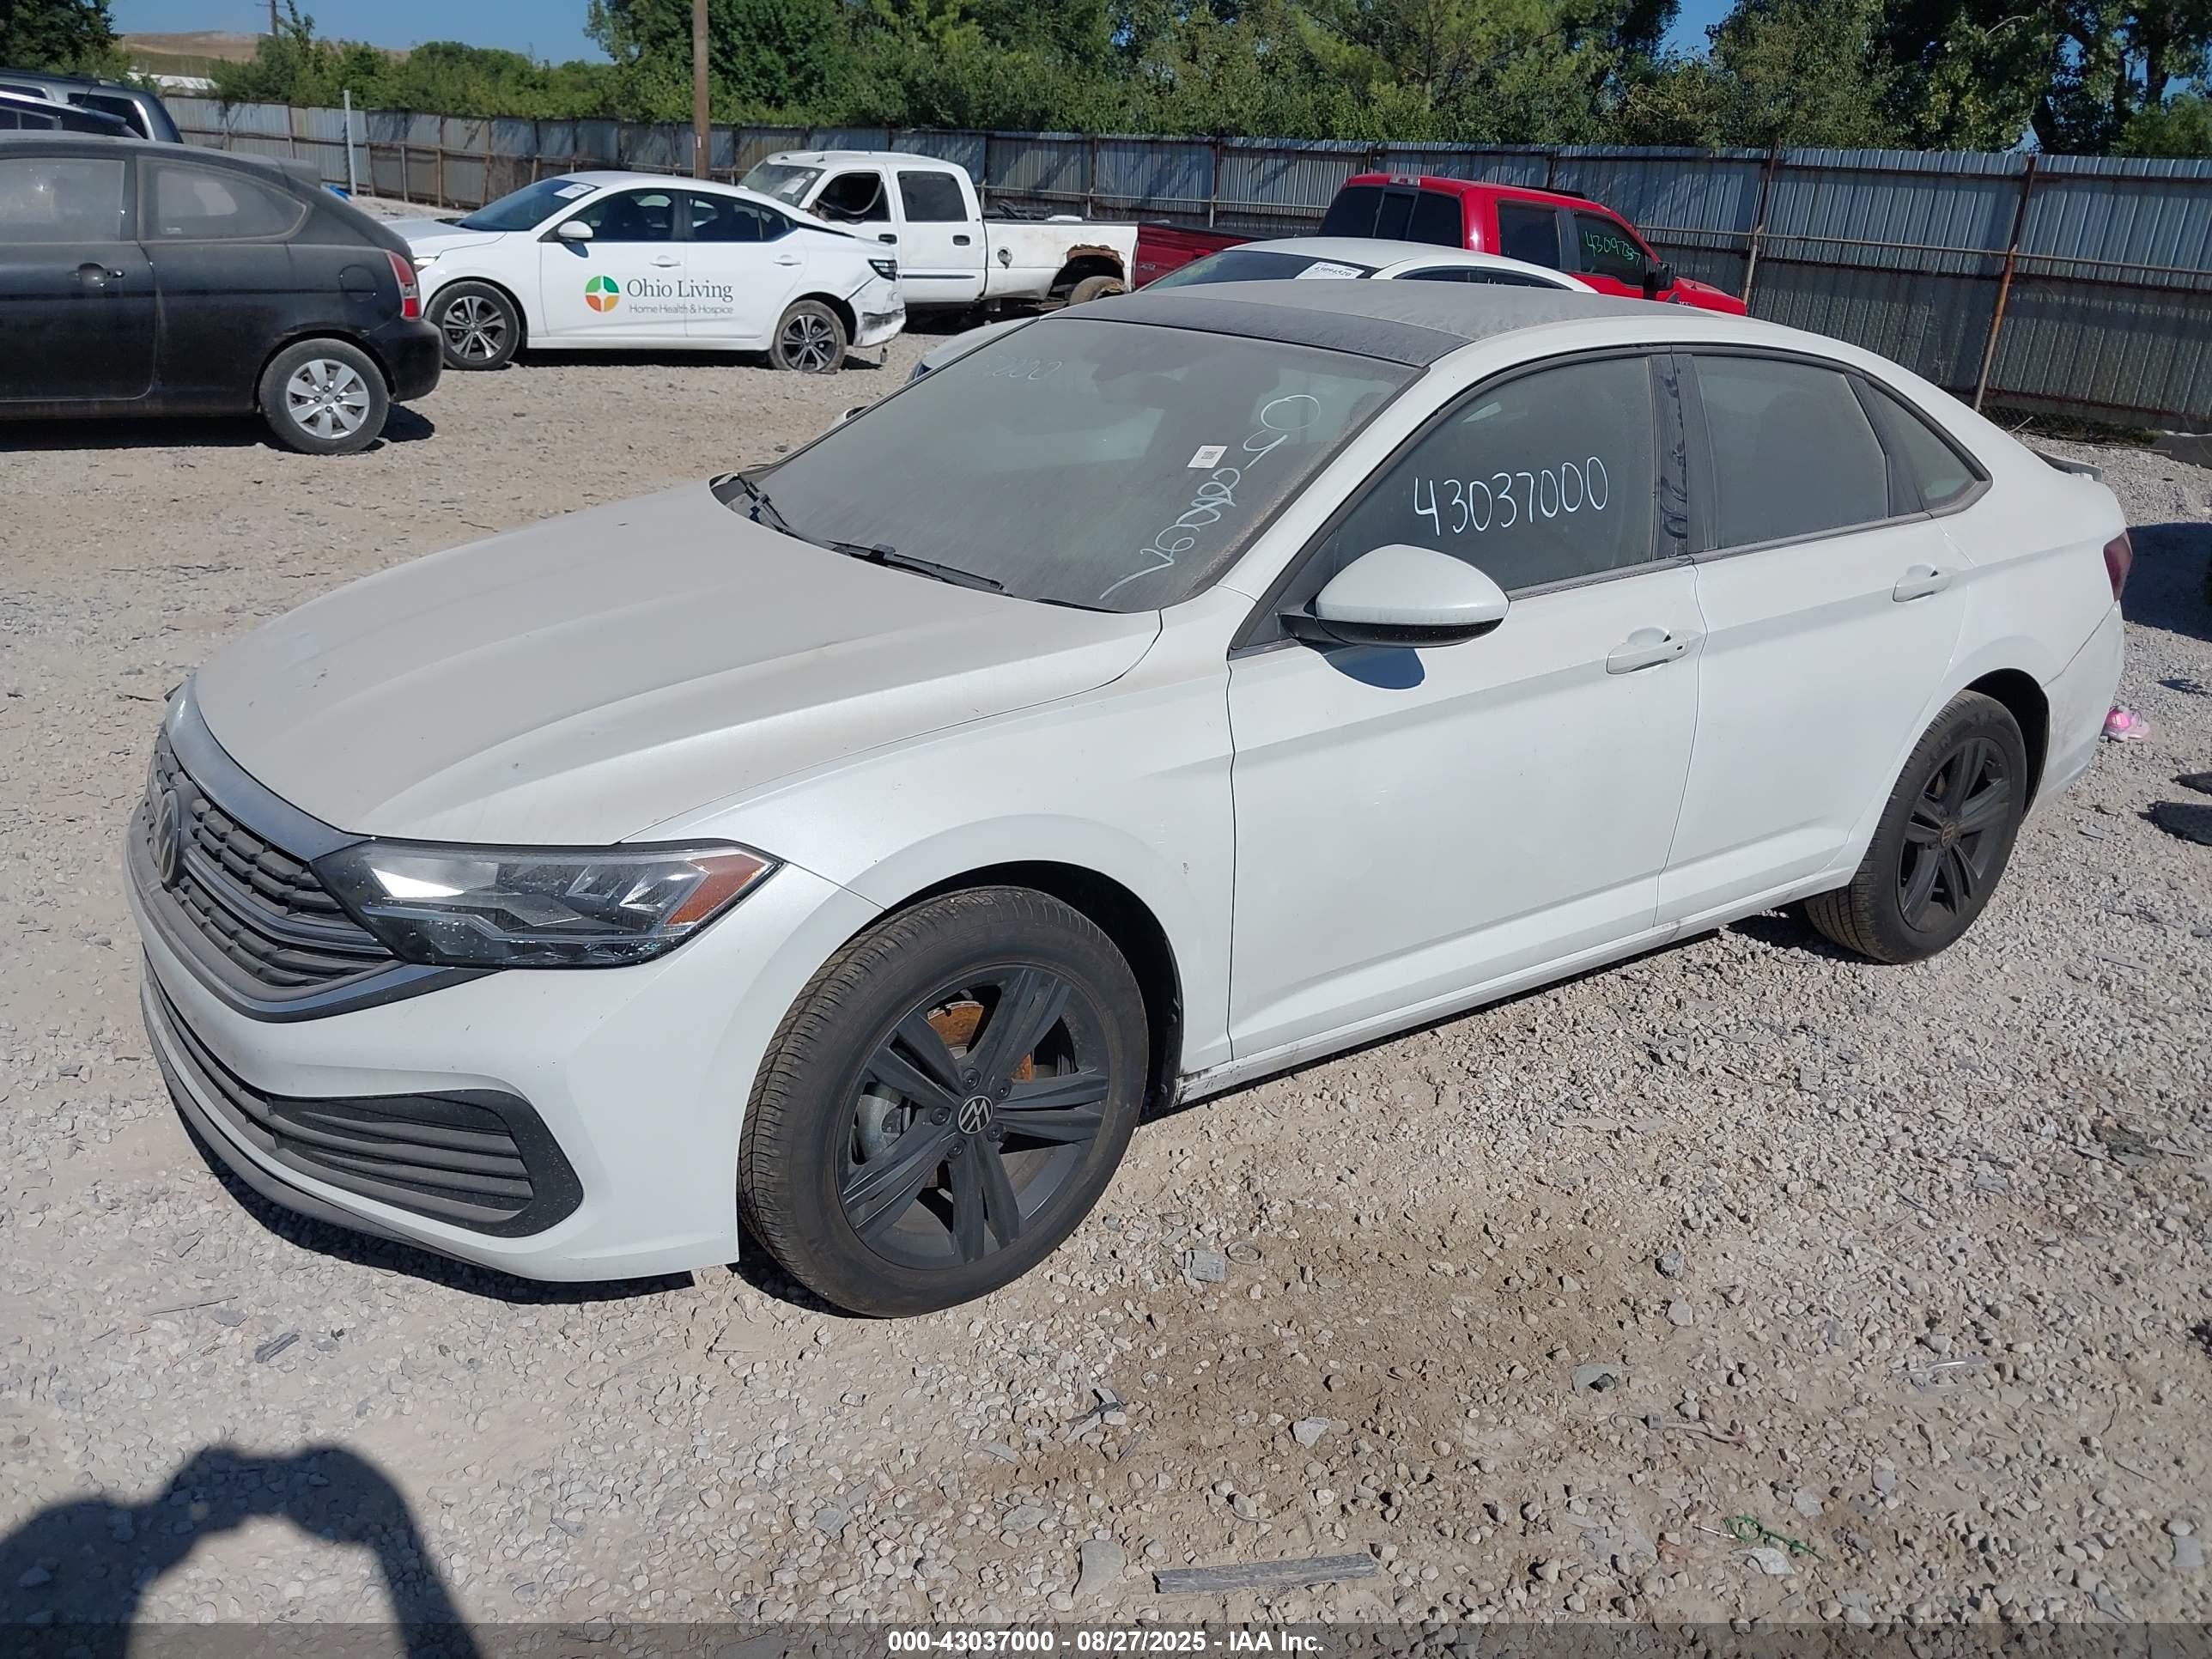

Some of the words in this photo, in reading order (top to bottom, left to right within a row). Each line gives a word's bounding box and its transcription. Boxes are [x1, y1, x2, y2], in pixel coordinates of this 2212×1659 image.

[627, 278, 672, 298] Ohio
[677, 279, 733, 303] Living
[629, 303, 659, 314] Home
[659, 303, 688, 314] Health
[689, 304, 697, 314] &
[698, 304, 734, 316] Hospice
[1413, 456, 1608, 537] 43037000
